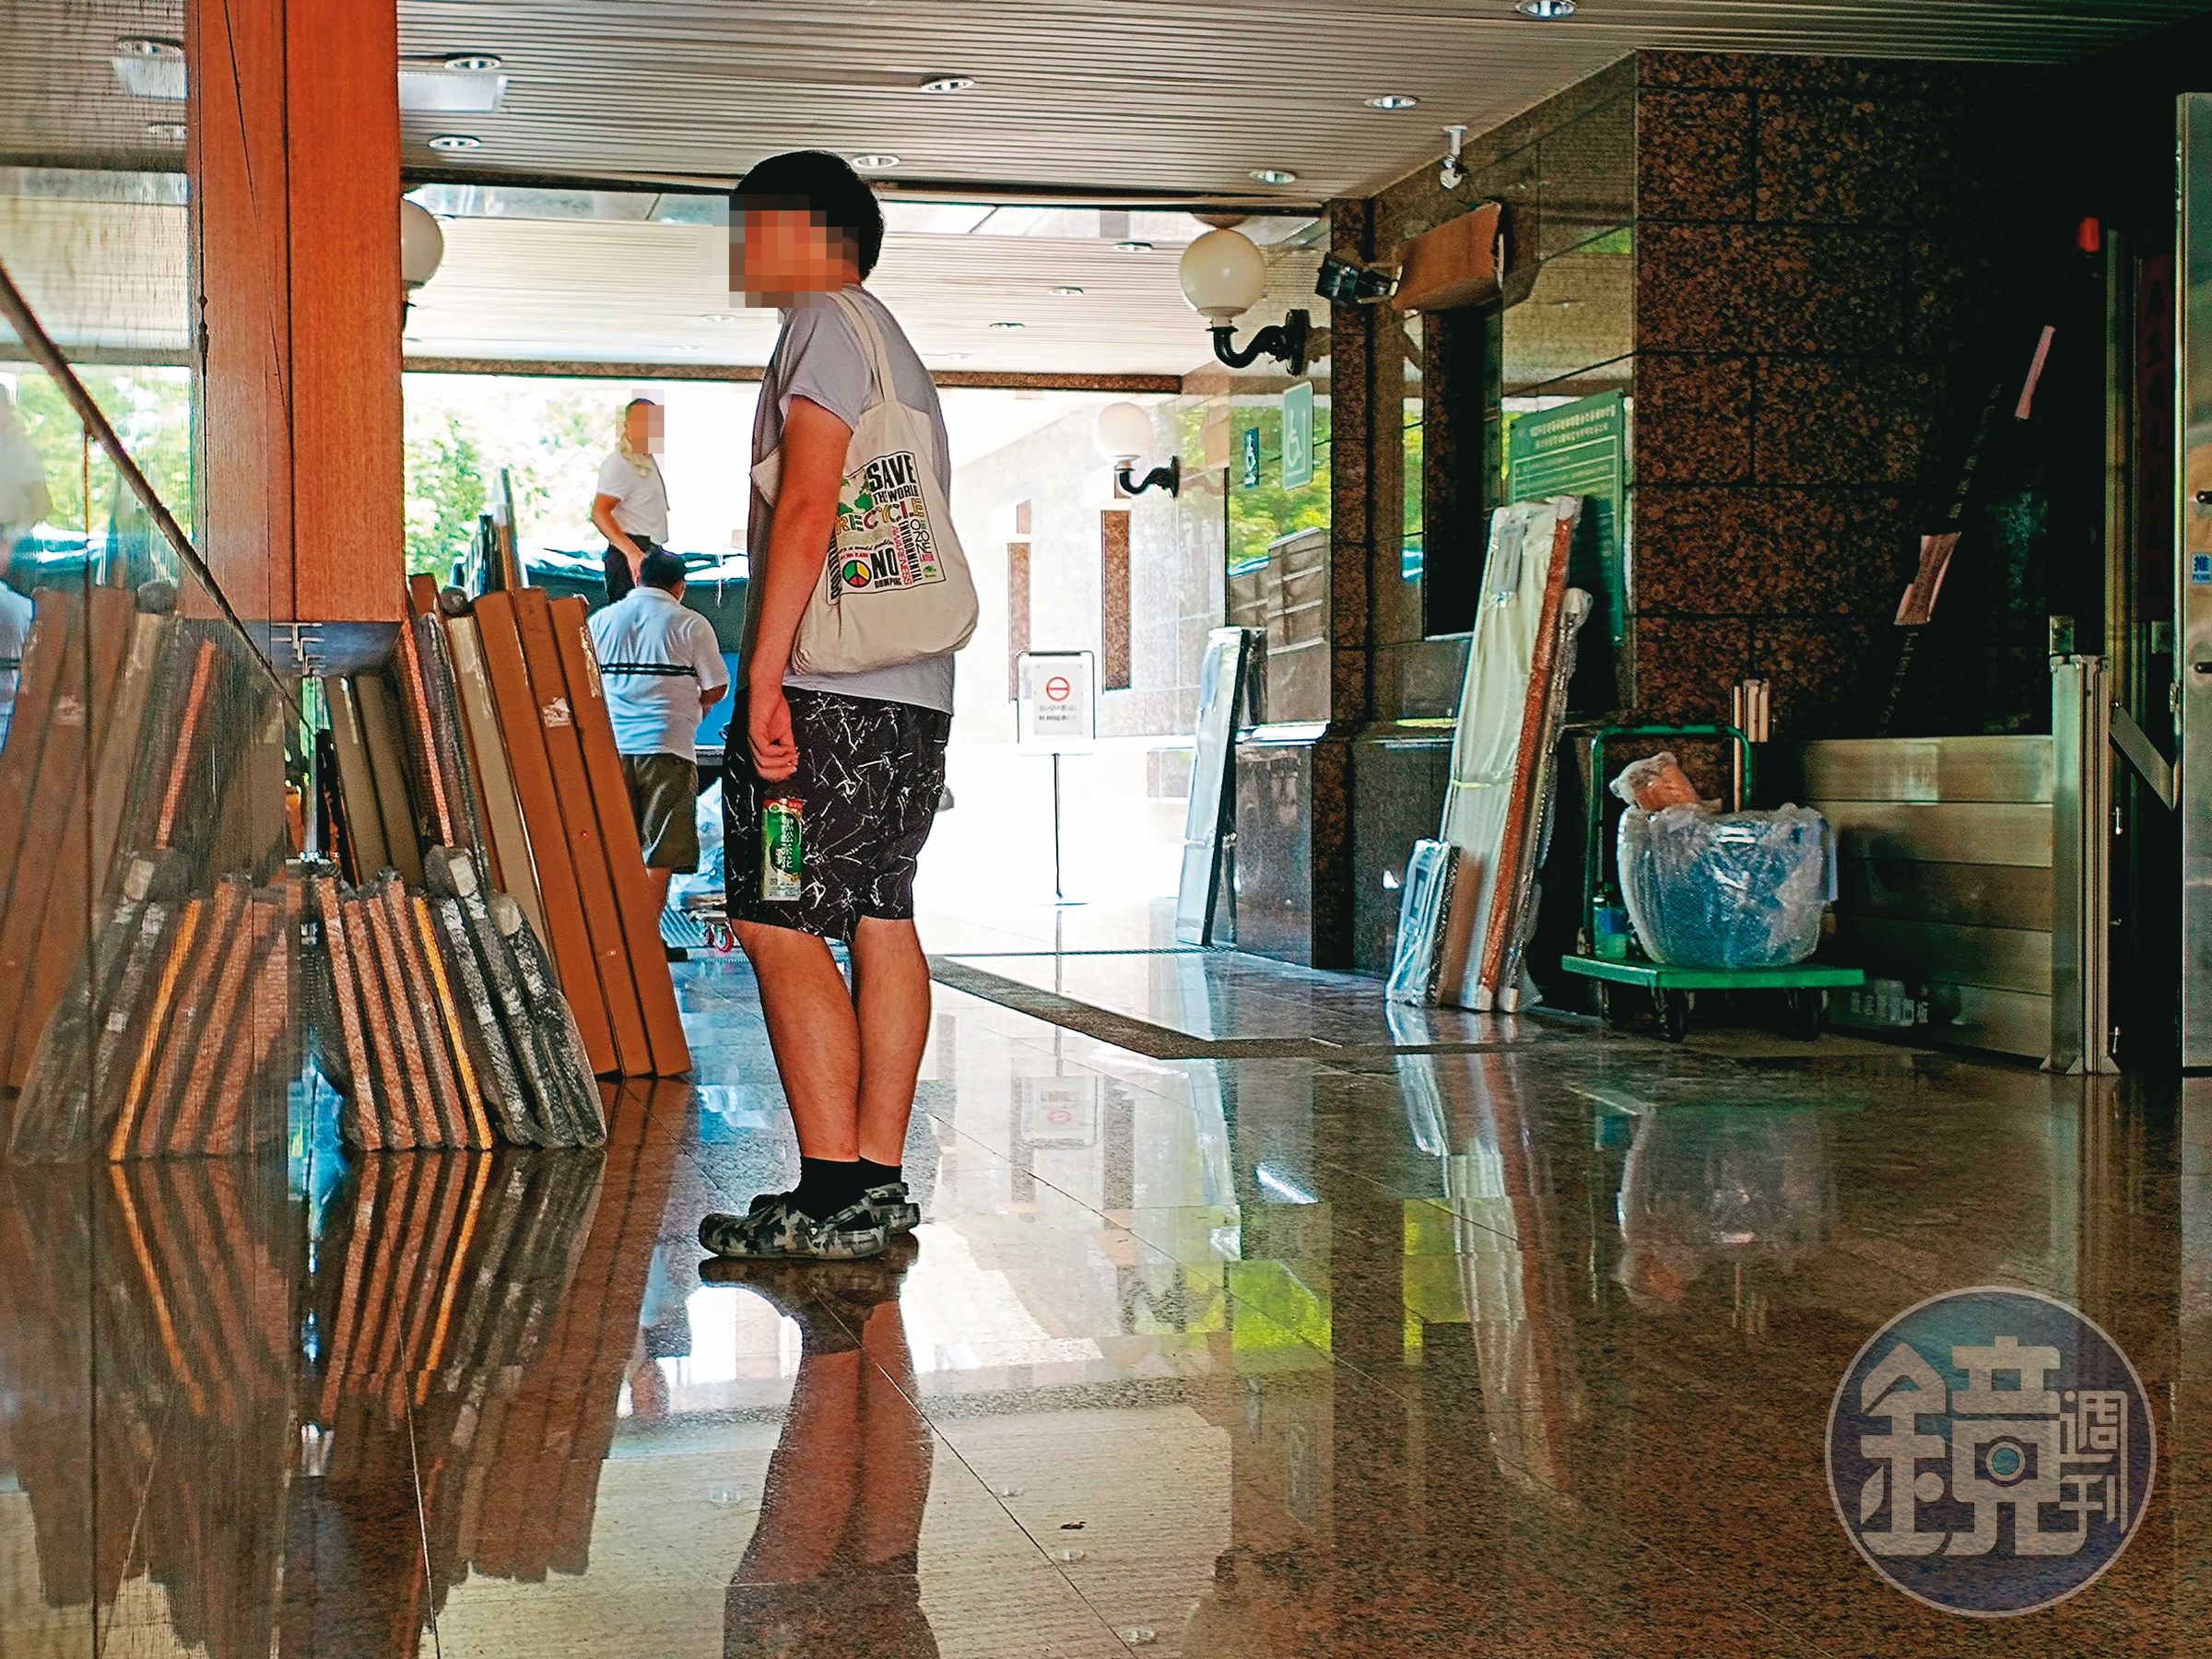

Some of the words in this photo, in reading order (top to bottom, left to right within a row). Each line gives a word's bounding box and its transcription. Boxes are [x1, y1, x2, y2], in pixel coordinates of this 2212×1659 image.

[867, 454, 916, 492] SAVE
[836, 498, 924, 535] RECYCLE
[870, 547, 900, 579] NO
[892, 525, 912, 585] AWARENESS
[899, 521, 923, 582] ENVIRONMENTAL
[2194, 555, 2209, 571] 推
